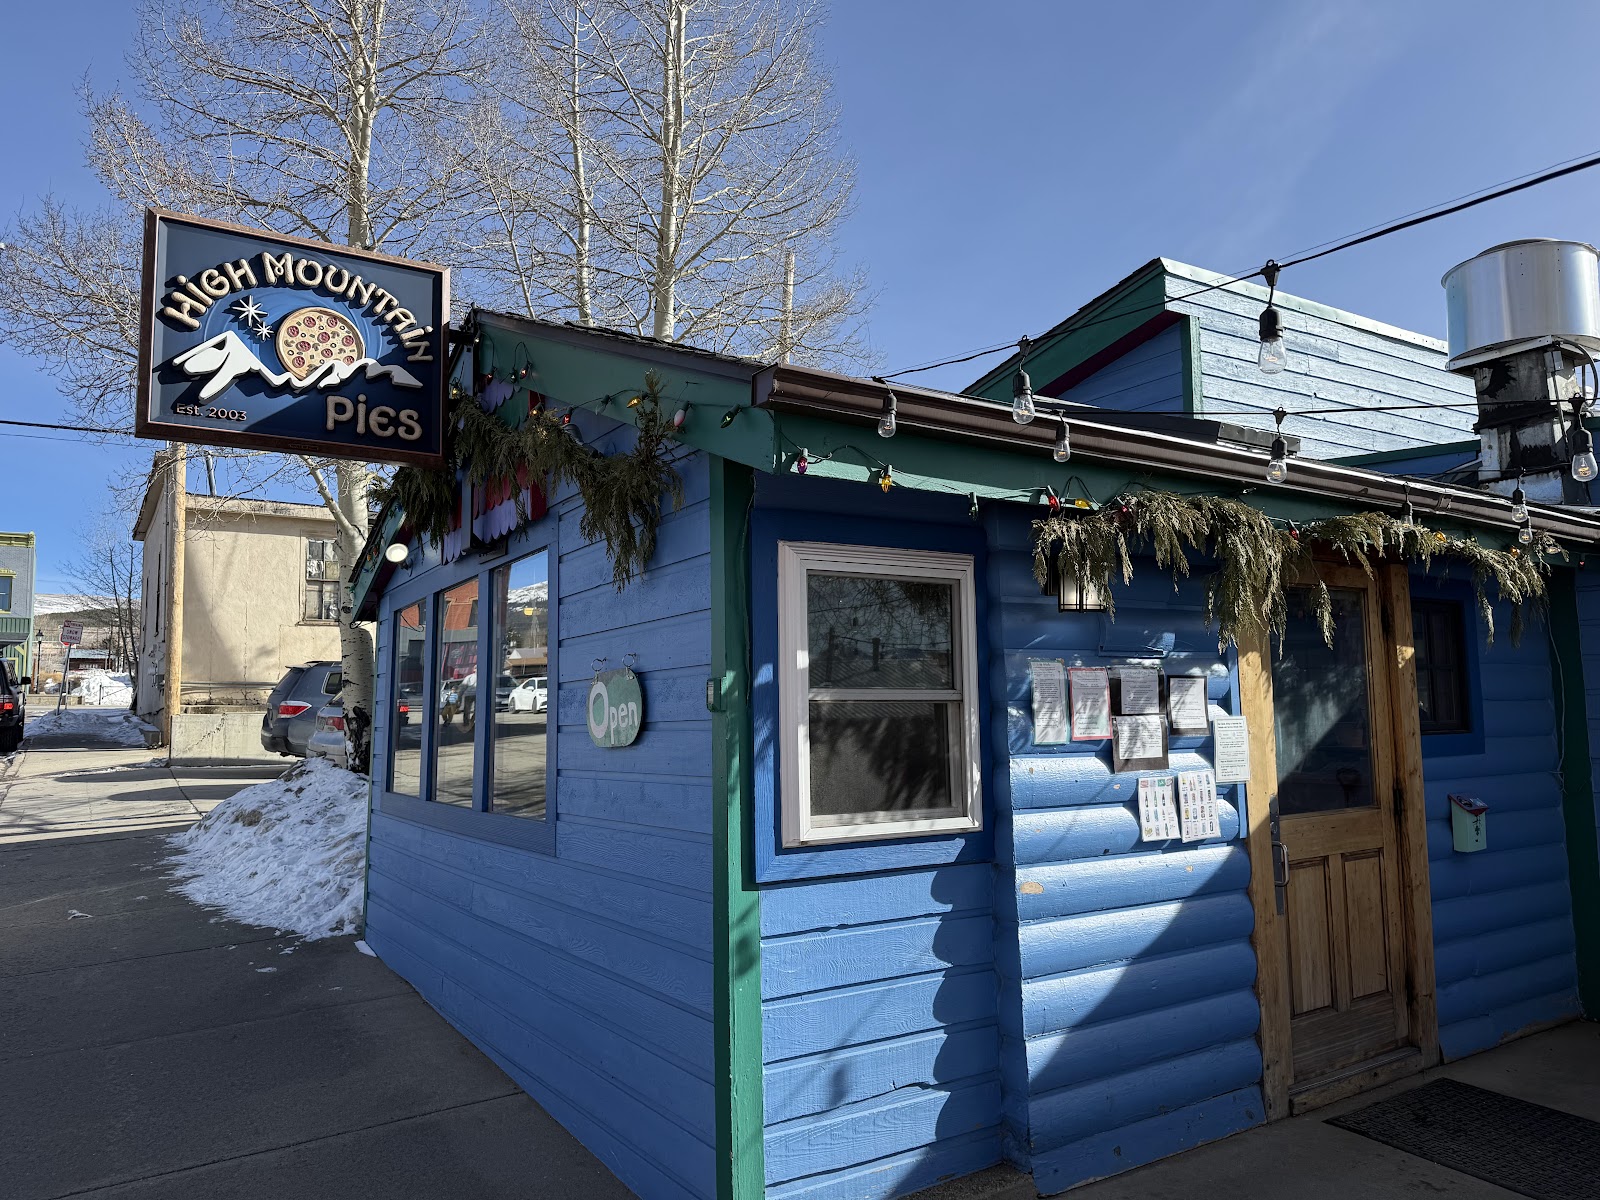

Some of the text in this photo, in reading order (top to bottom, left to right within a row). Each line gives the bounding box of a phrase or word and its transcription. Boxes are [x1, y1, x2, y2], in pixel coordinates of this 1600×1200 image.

[176, 402, 248, 421] Est. 2003
[589, 681, 639, 745] Open
